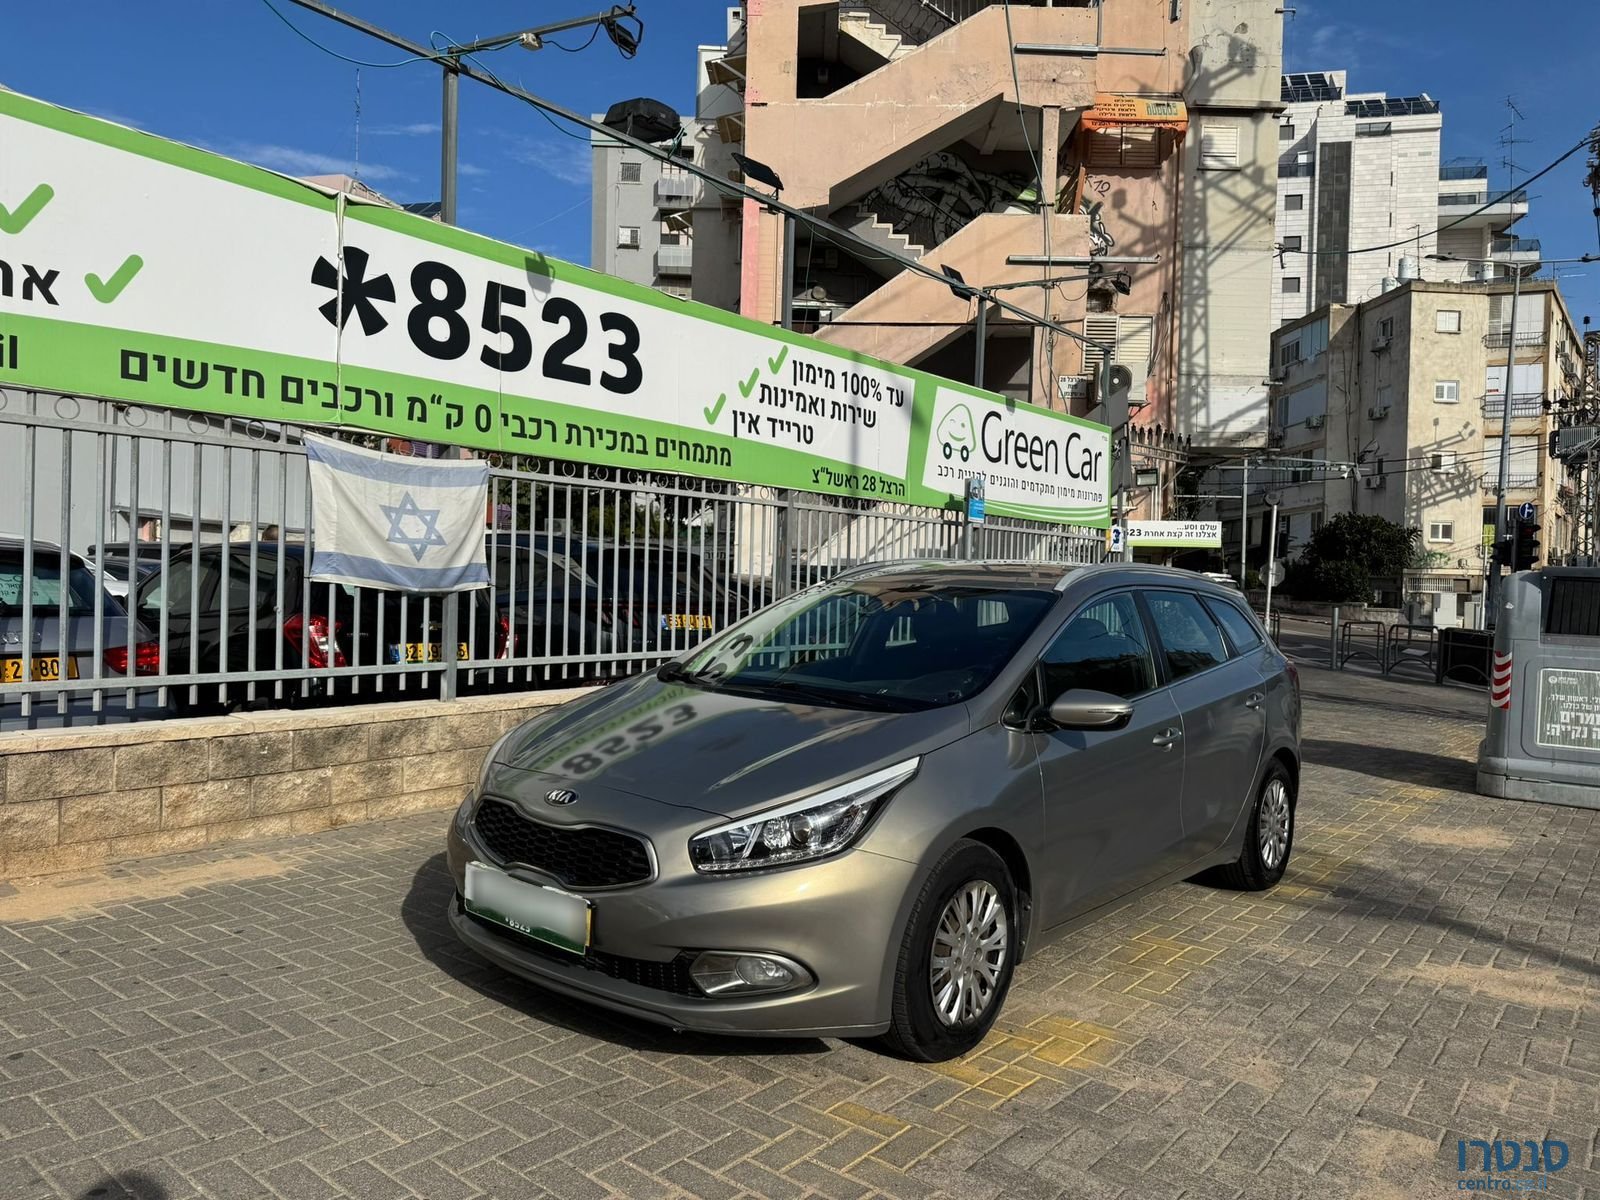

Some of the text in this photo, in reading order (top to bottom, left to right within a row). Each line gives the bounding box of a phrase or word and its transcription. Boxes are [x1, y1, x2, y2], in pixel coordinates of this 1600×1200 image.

[120, 349, 265, 399] חדשים
[792, 360, 904, 407] עד 100% מימון
[281, 375, 394, 418] ורכבים
[759, 383, 877, 428] שירות ואמינות
[475, 404, 492, 432] 0
[500, 413, 557, 442] רכבי
[732, 409, 814, 445] טרייד אין
[565, 422, 649, 455] במכירת
[655, 436, 732, 467] מתמחים
[981, 410, 1102, 482] Green Car
[862, 474, 876, 492] 28
[937, 465, 955, 478] רכב
[990, 474, 1019, 490] והוגנים
[879, 477, 906, 496] הרצל
[1021, 480, 1055, 496] מתקדמים
[1057, 486, 1075, 499] מימון
[1077, 488, 1103, 503] פתרונות
[548, 790, 572, 803] KIA
